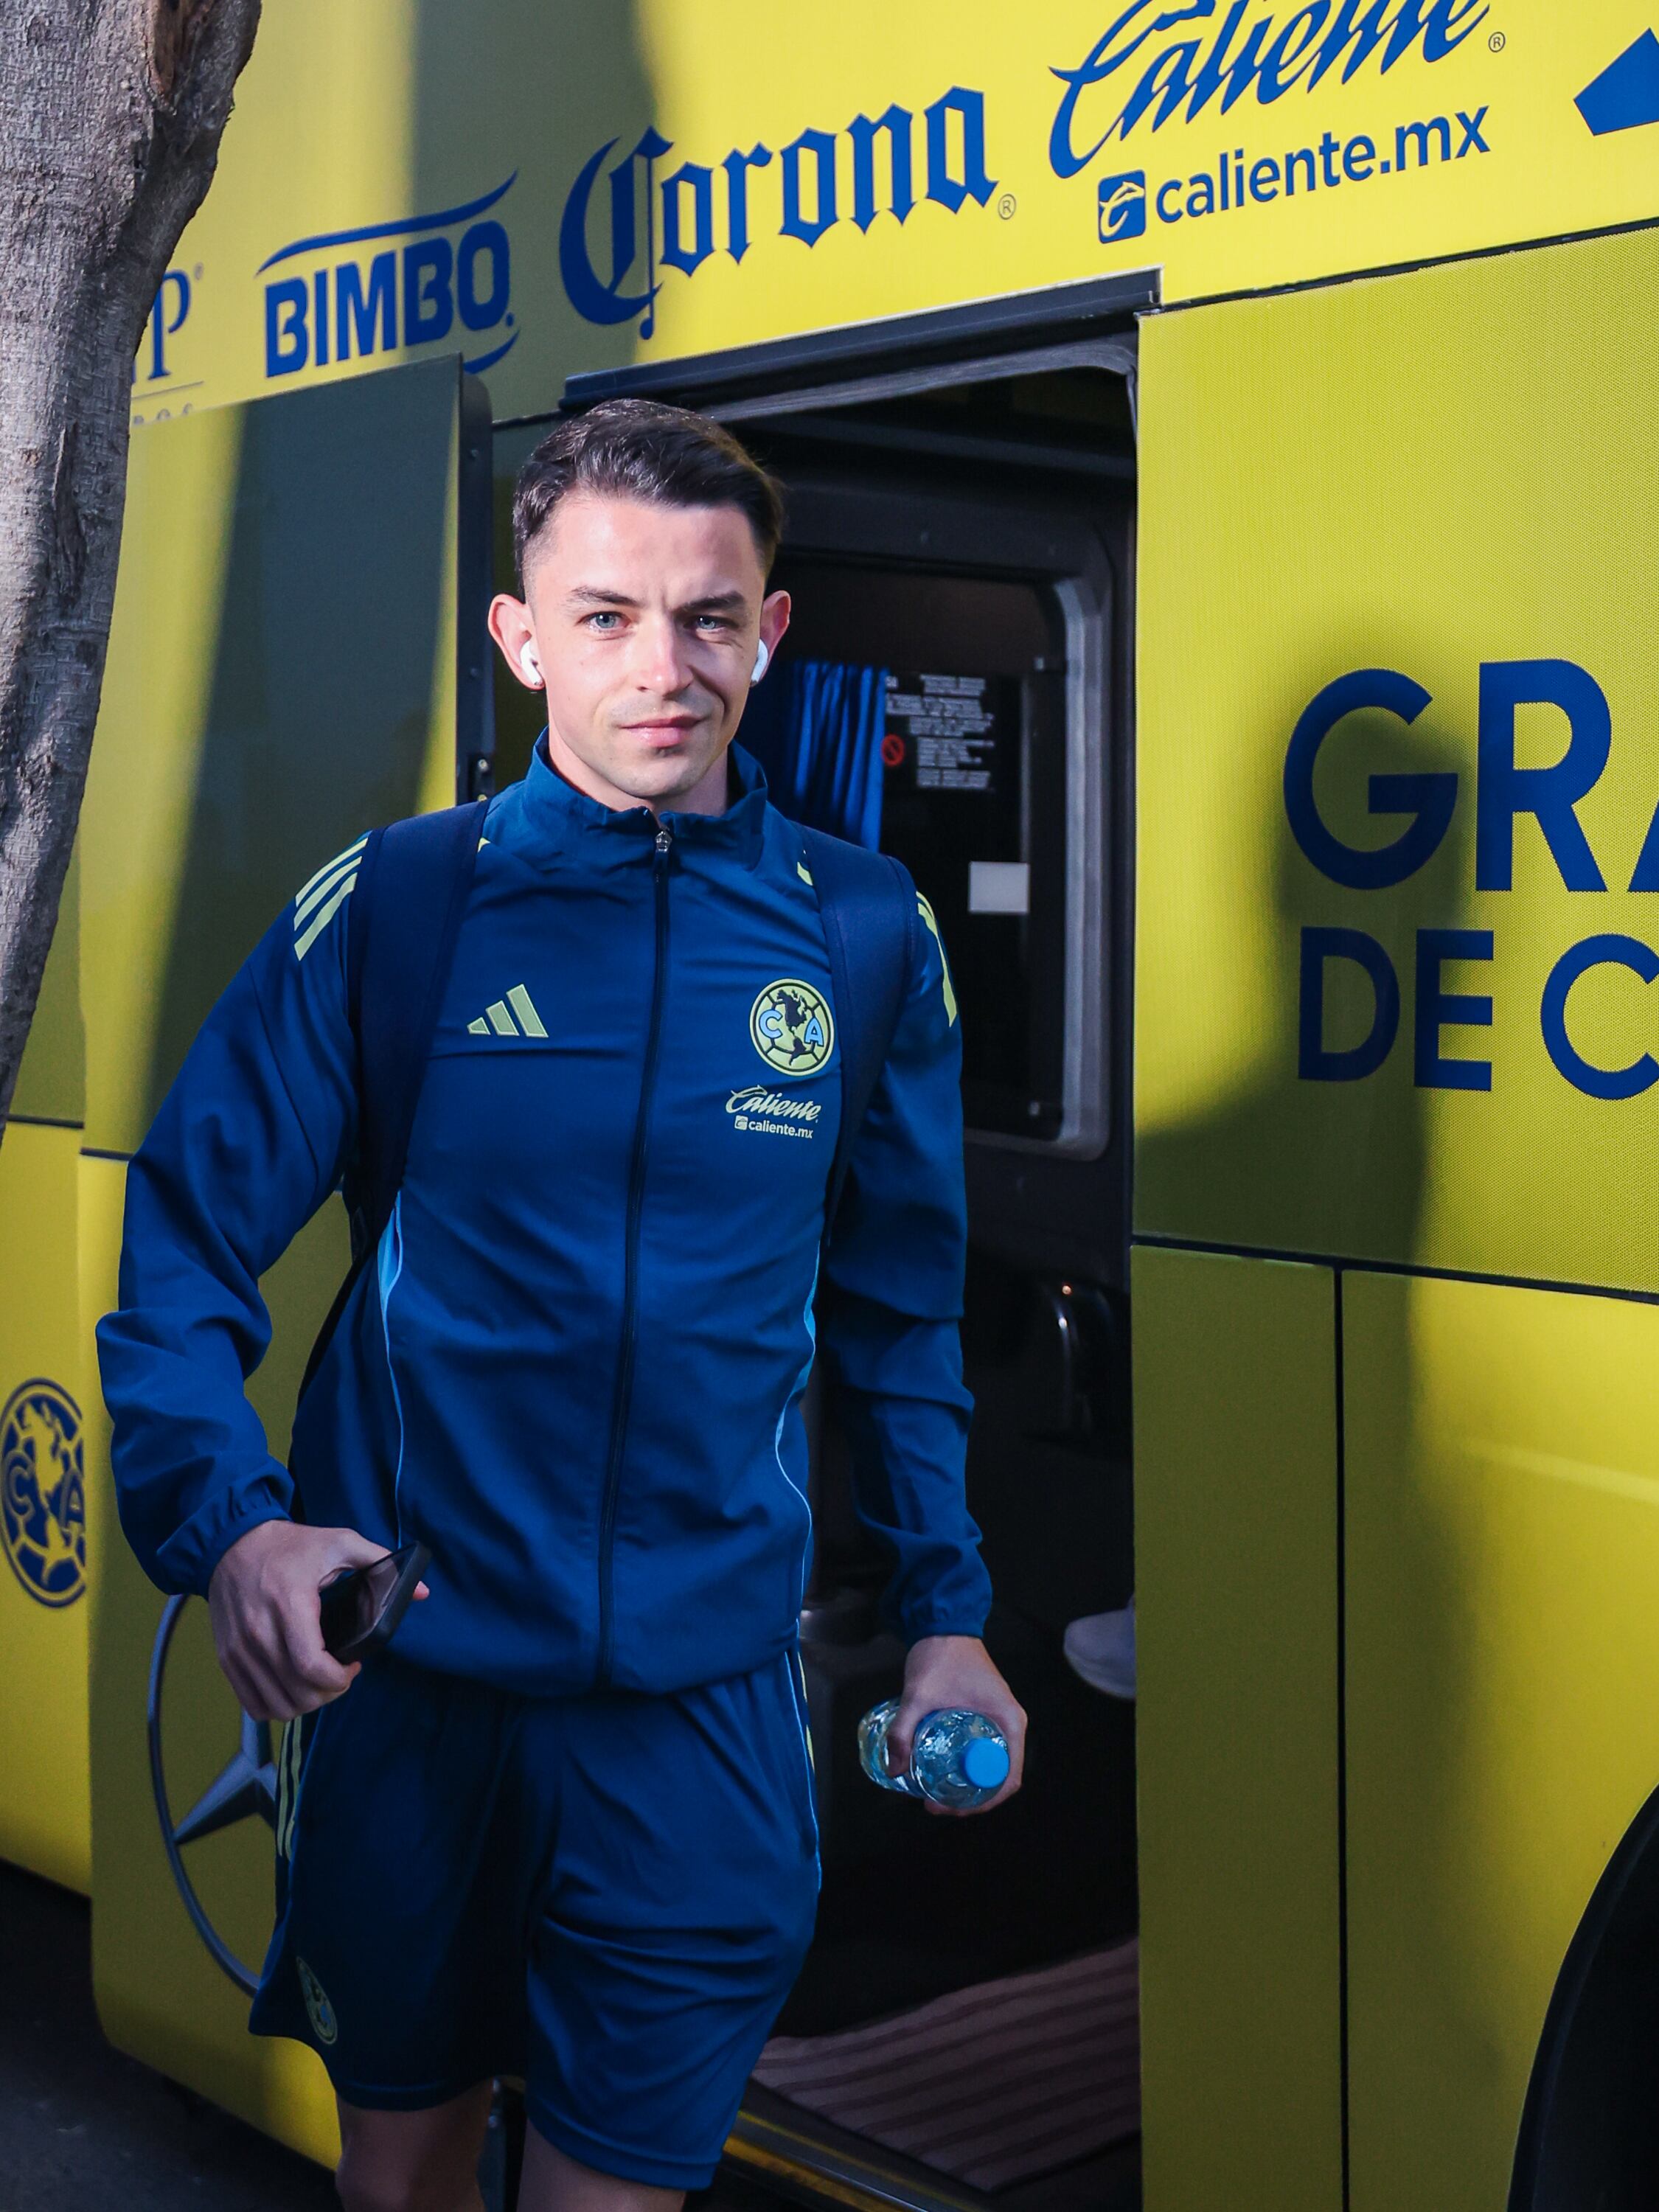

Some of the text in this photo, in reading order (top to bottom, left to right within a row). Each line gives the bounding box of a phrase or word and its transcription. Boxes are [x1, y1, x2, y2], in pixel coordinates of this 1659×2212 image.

[559, 86, 998, 340] Corona
[1155, 105, 1490, 223] caliente.mx
[131, 268, 192, 384] P
[265, 219, 510, 378] BIMBO
[1283, 658, 1659, 892] GR
[1298, 925, 1659, 1100] DE C
[726, 1084, 821, 1121] Caliente
[748, 1119, 814, 1139] caliente.mx
